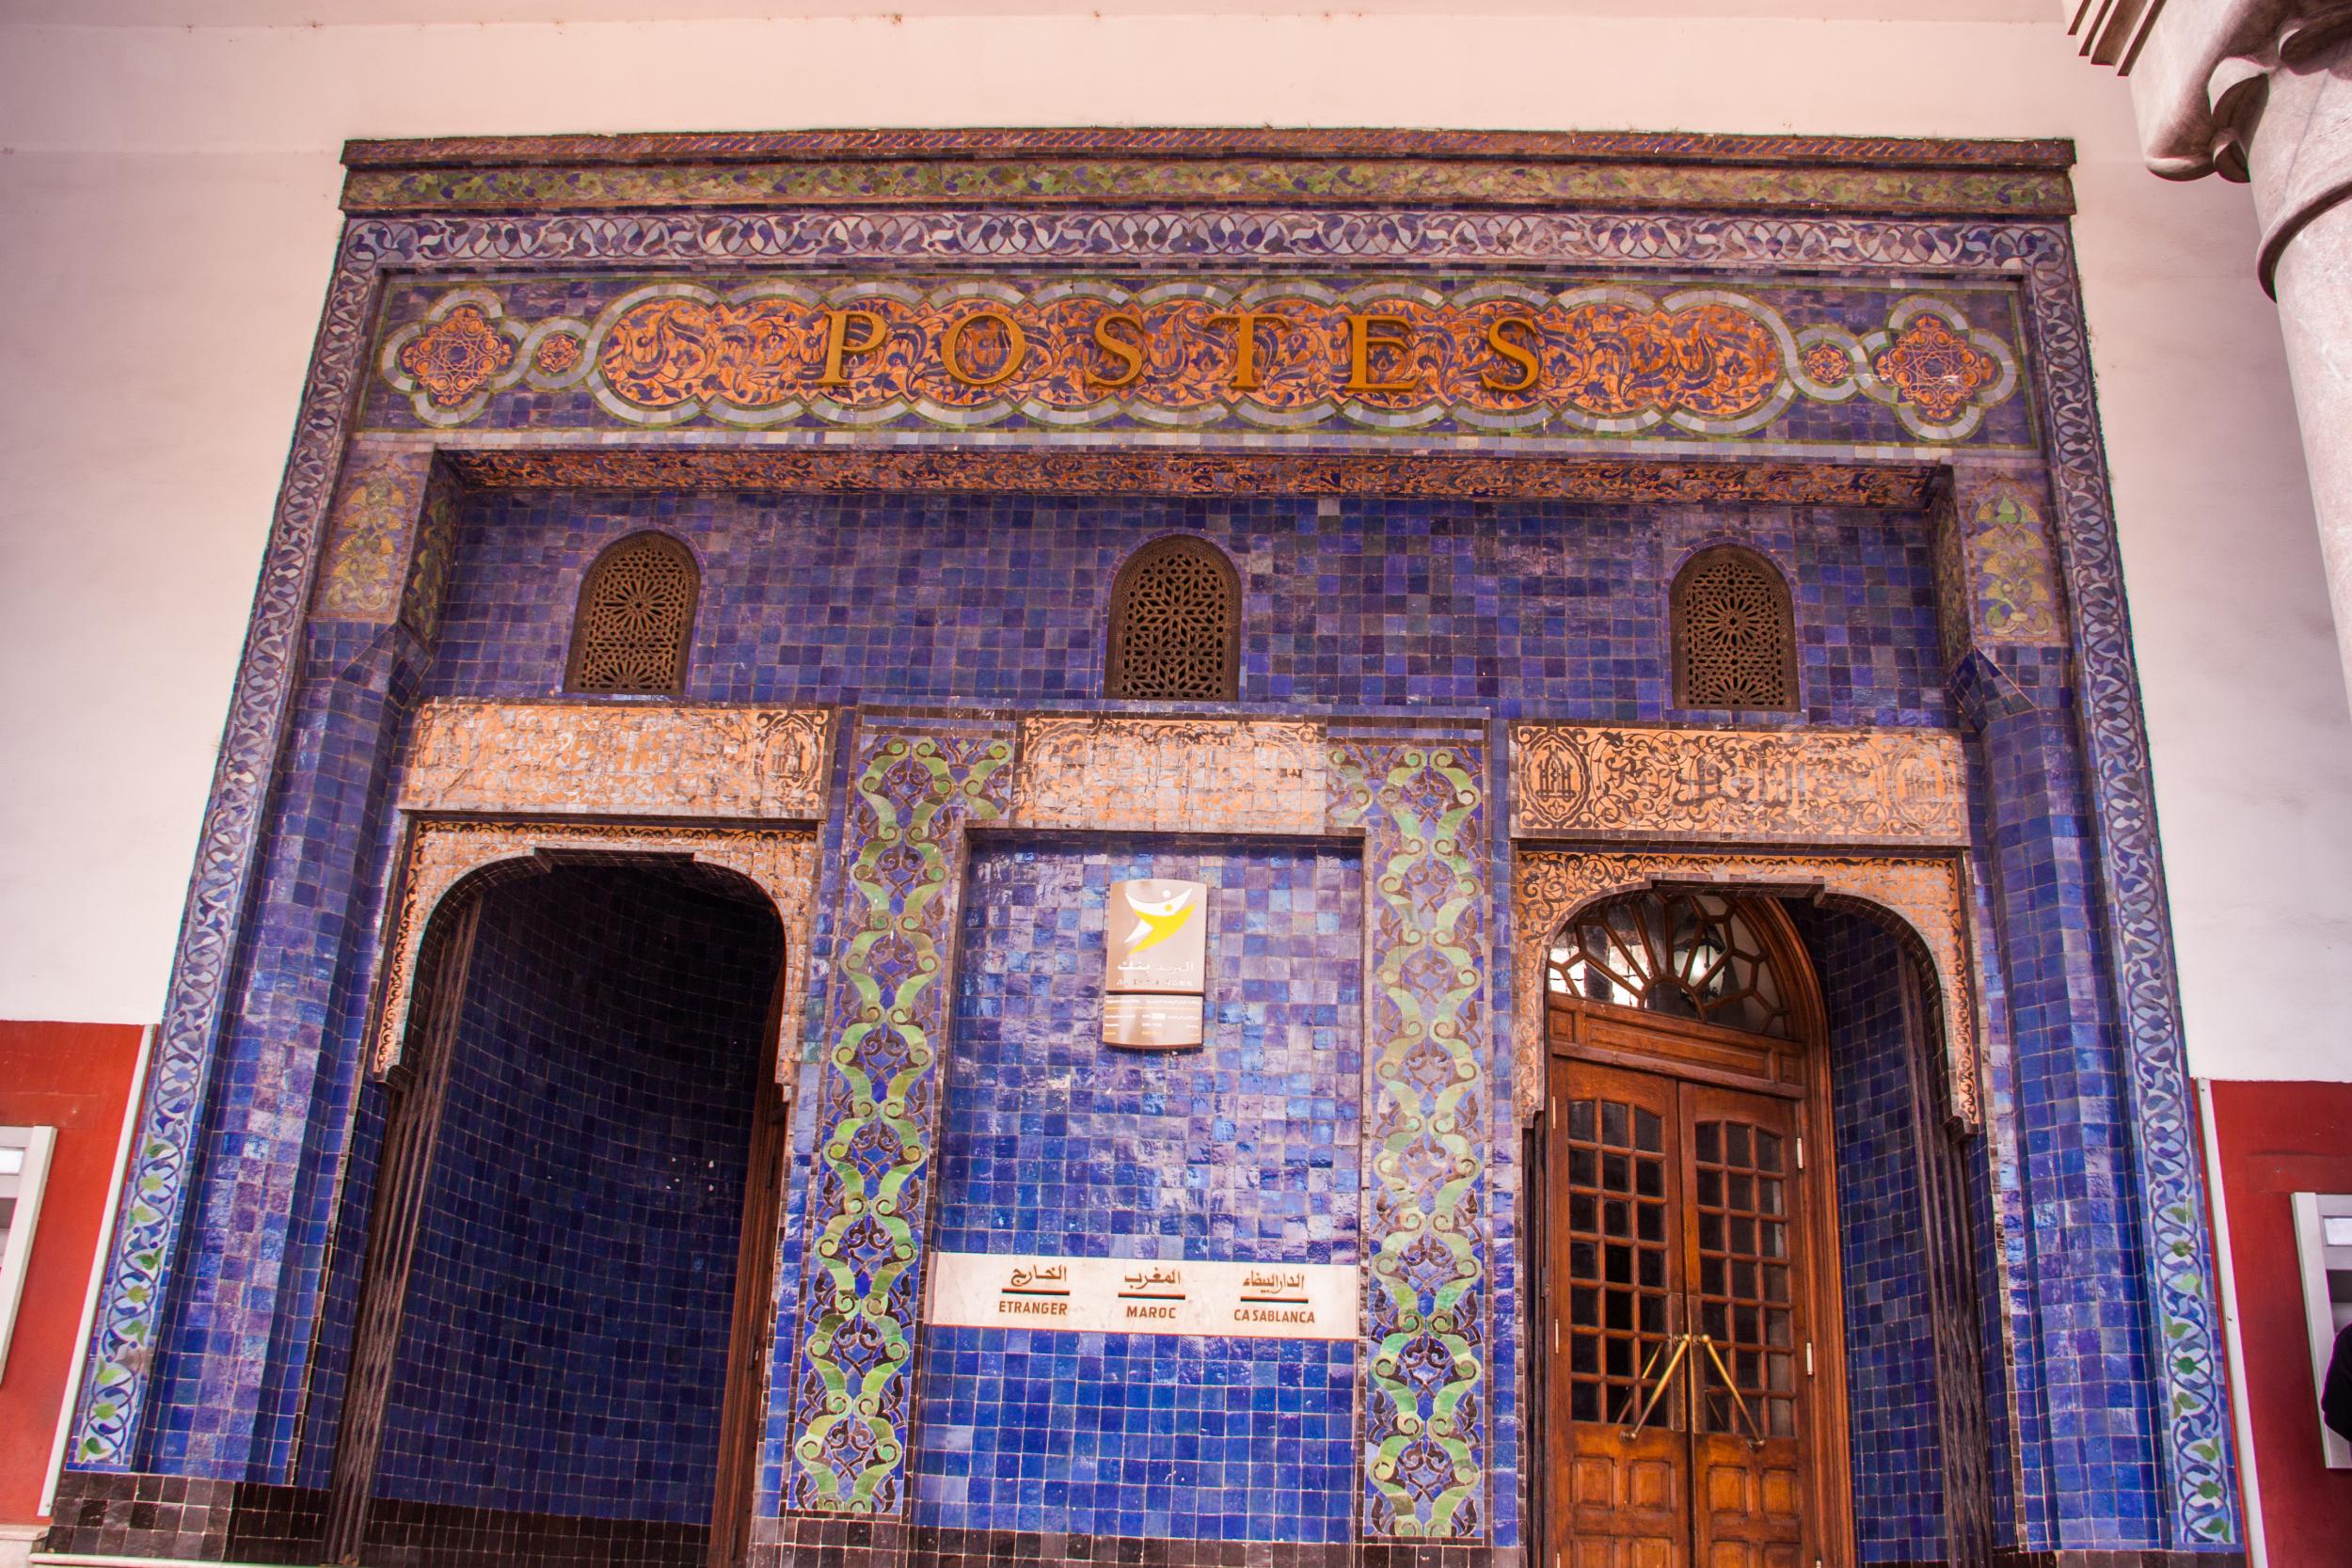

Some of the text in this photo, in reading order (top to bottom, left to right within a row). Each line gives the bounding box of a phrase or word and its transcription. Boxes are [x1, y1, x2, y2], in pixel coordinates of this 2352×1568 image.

[815, 311, 1546, 391] POSTES
[1010, 1264, 1067, 1287] الخارج
[1124, 1266, 1182, 1290] المغرب
[998, 1300, 1069, 1316] ETRANGER
[1126, 1305, 1177, 1320] MAROC
[1233, 1308, 1316, 1323] CASABLANCA
